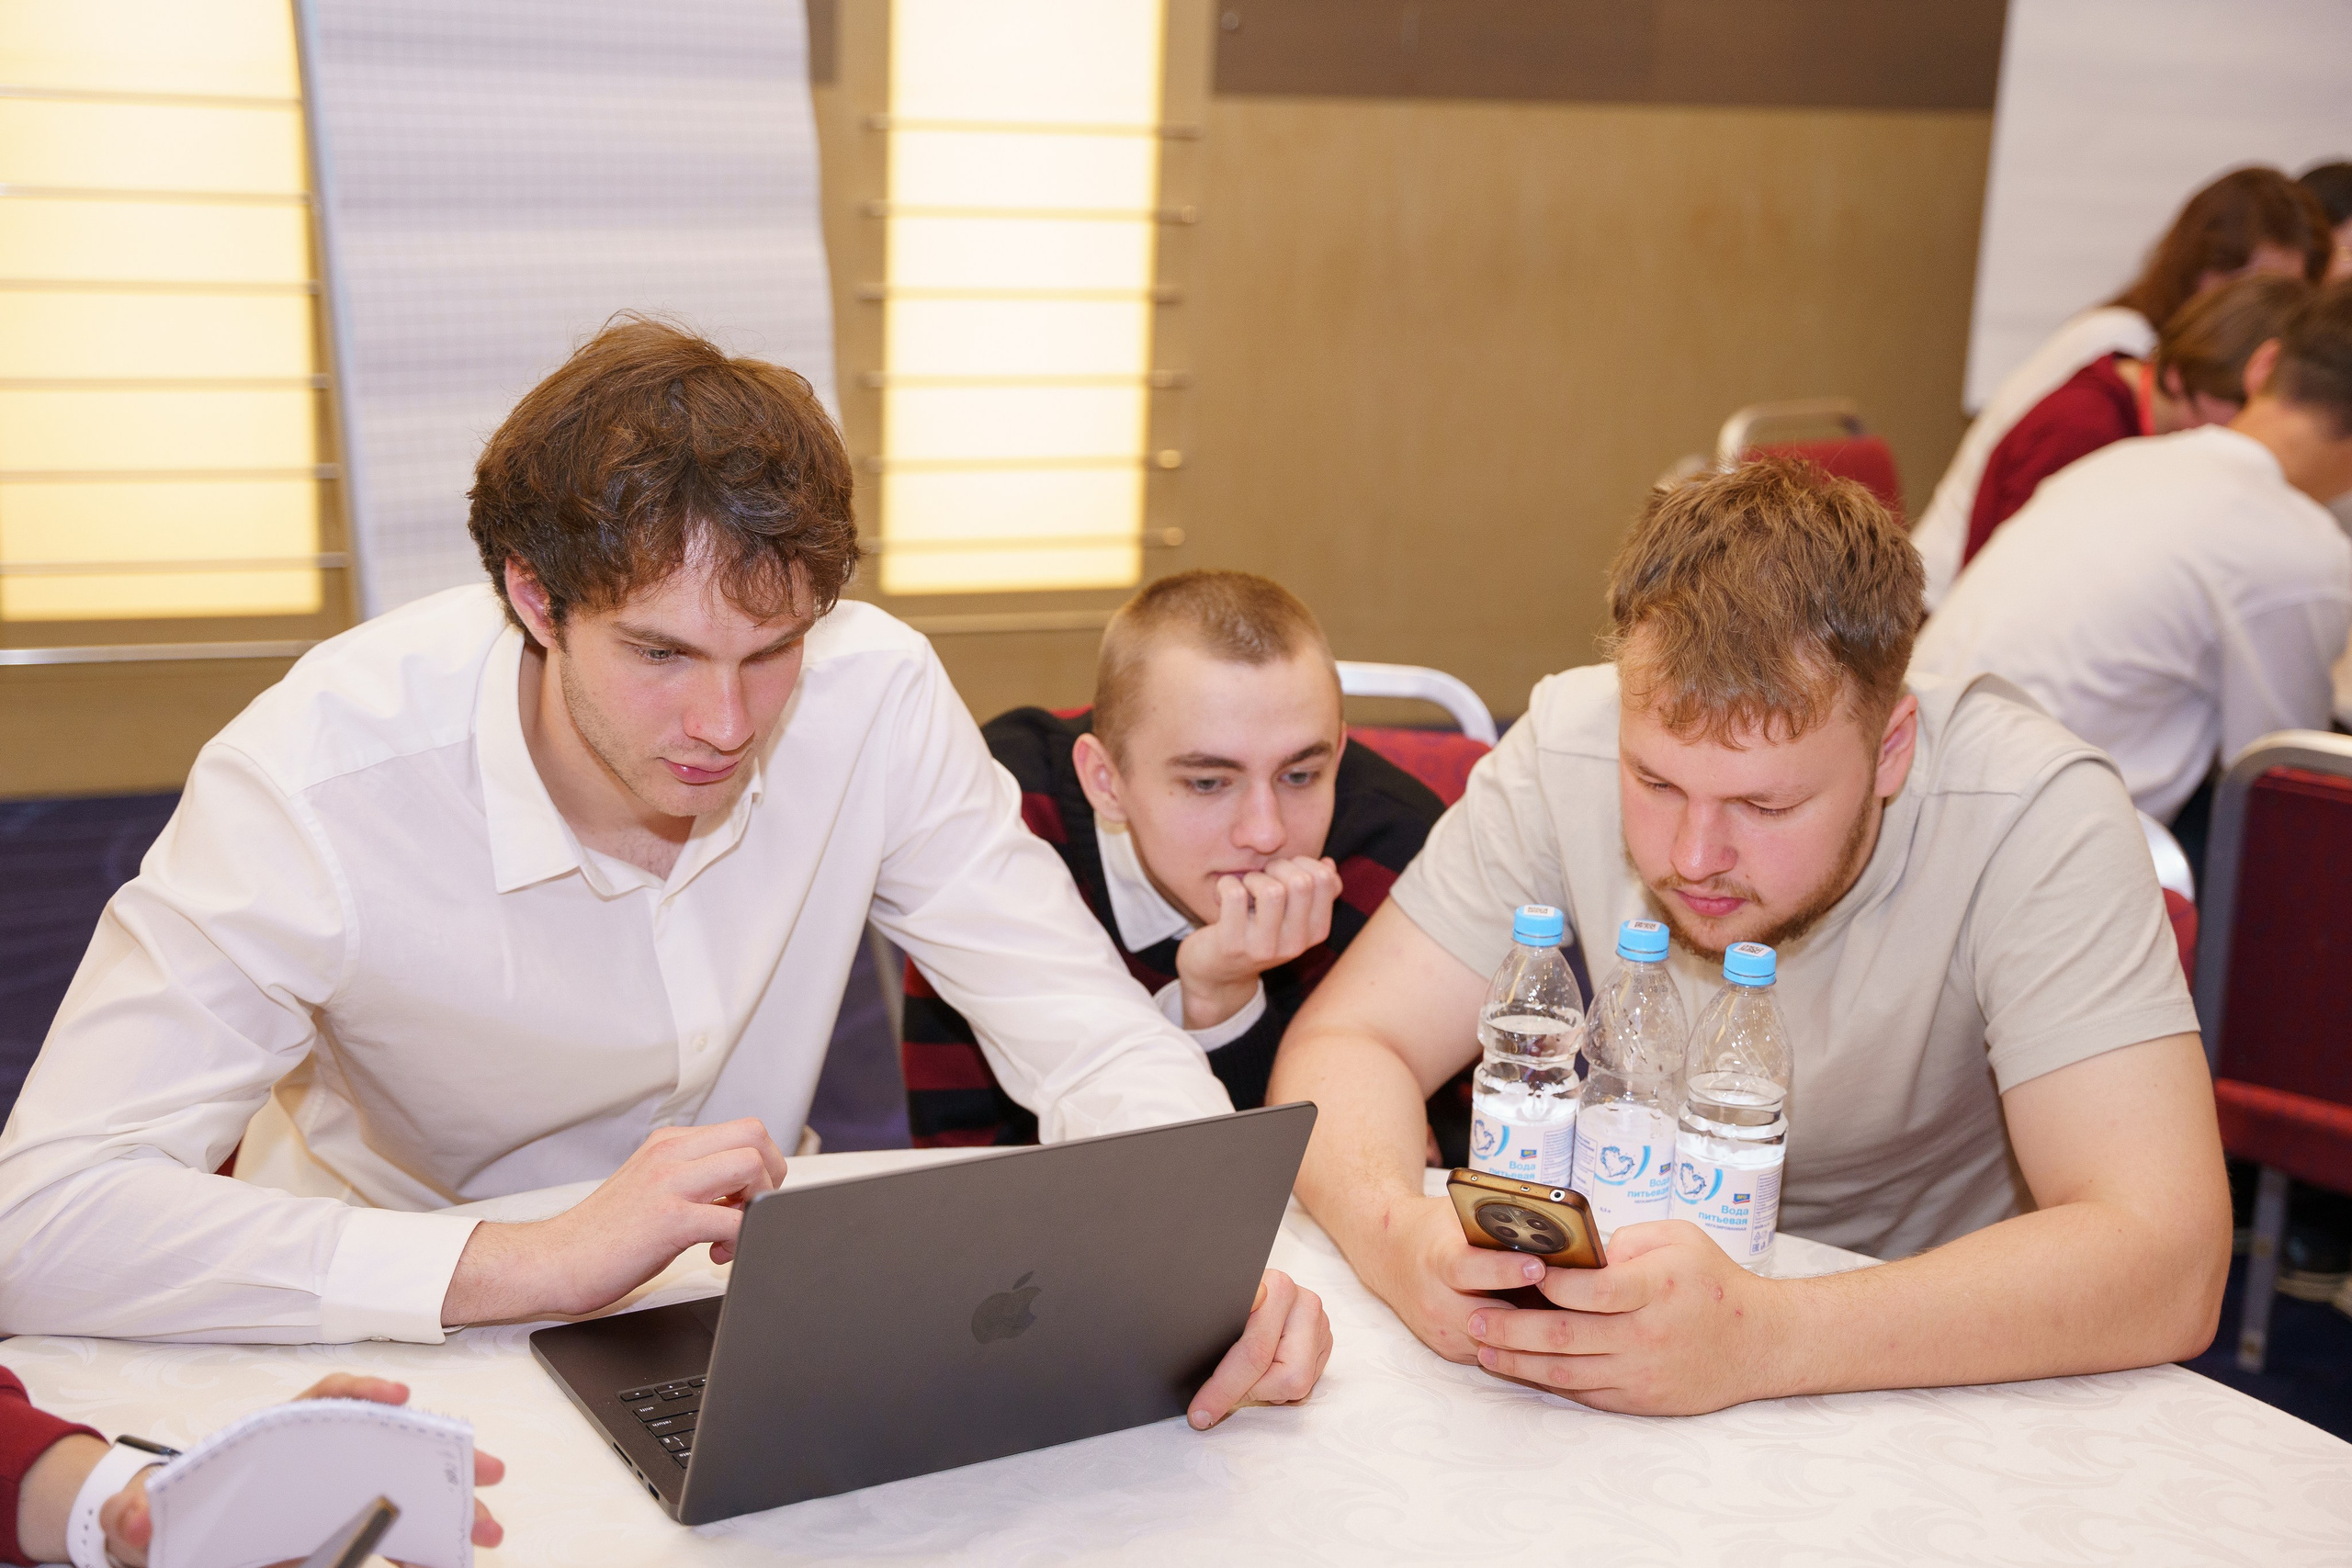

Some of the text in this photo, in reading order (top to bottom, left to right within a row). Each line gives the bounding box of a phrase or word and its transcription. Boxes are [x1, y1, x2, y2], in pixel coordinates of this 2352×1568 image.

[1509, 1160, 1536, 1171] Вода
[1721, 1204, 1749, 1215] Вода
[1698, 1212, 1747, 1224] питьевая
